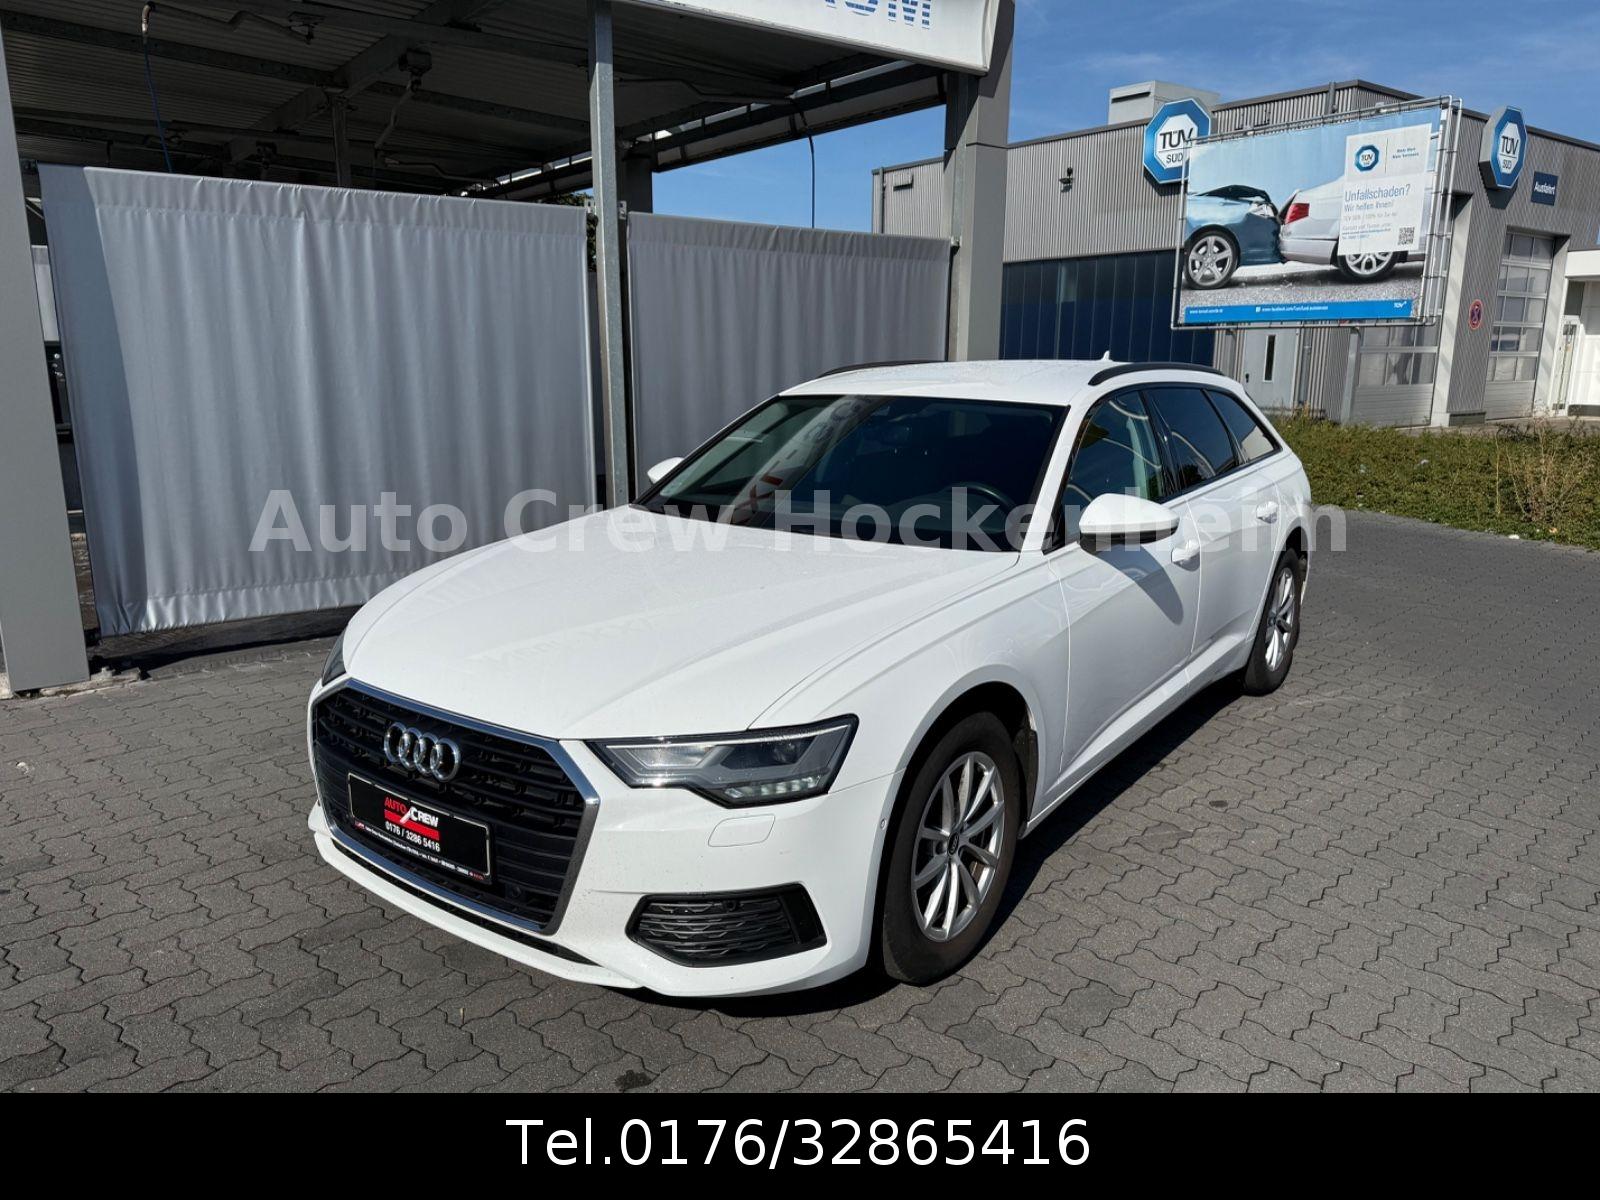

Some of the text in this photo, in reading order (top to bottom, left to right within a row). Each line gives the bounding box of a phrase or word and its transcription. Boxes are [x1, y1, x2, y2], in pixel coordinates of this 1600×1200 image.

[1159, 127, 1193, 149] TÜV
[1345, 183, 1411, 202] Unfallschaden?
[384, 797, 439, 828] AUTO CREW
[423, 837, 441, 852] 5416
